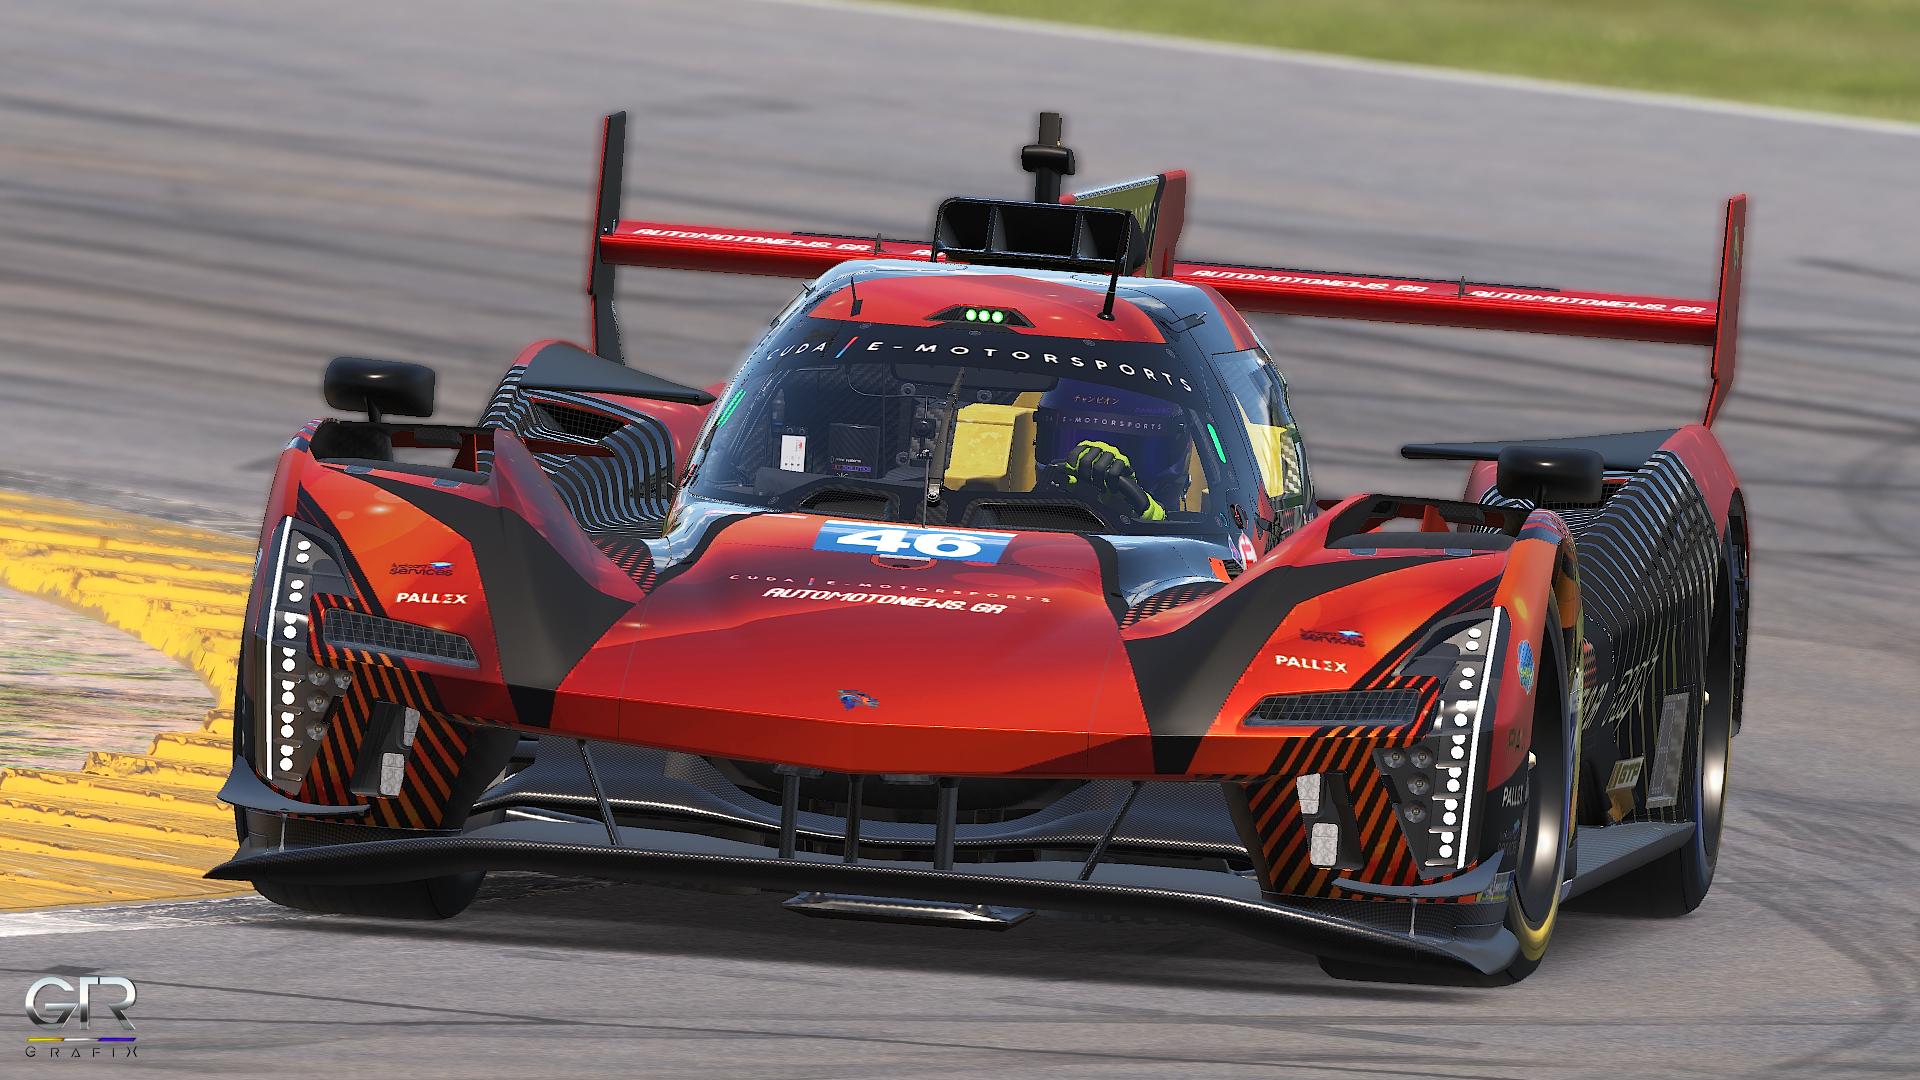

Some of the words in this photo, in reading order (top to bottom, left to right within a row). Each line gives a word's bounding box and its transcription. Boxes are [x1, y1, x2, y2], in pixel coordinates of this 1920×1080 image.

[766, 341, 827, 361] CUDA
[866, 340, 1193, 393] E-MOTORSPORTS
[836, 529, 982, 558] 46
[396, 592, 469, 605] PALLEX
[729, 574, 795, 584] CUDA
[826, 580, 1052, 603] E-MOTORSPORTS
[1274, 654, 1348, 674] PALLEX
